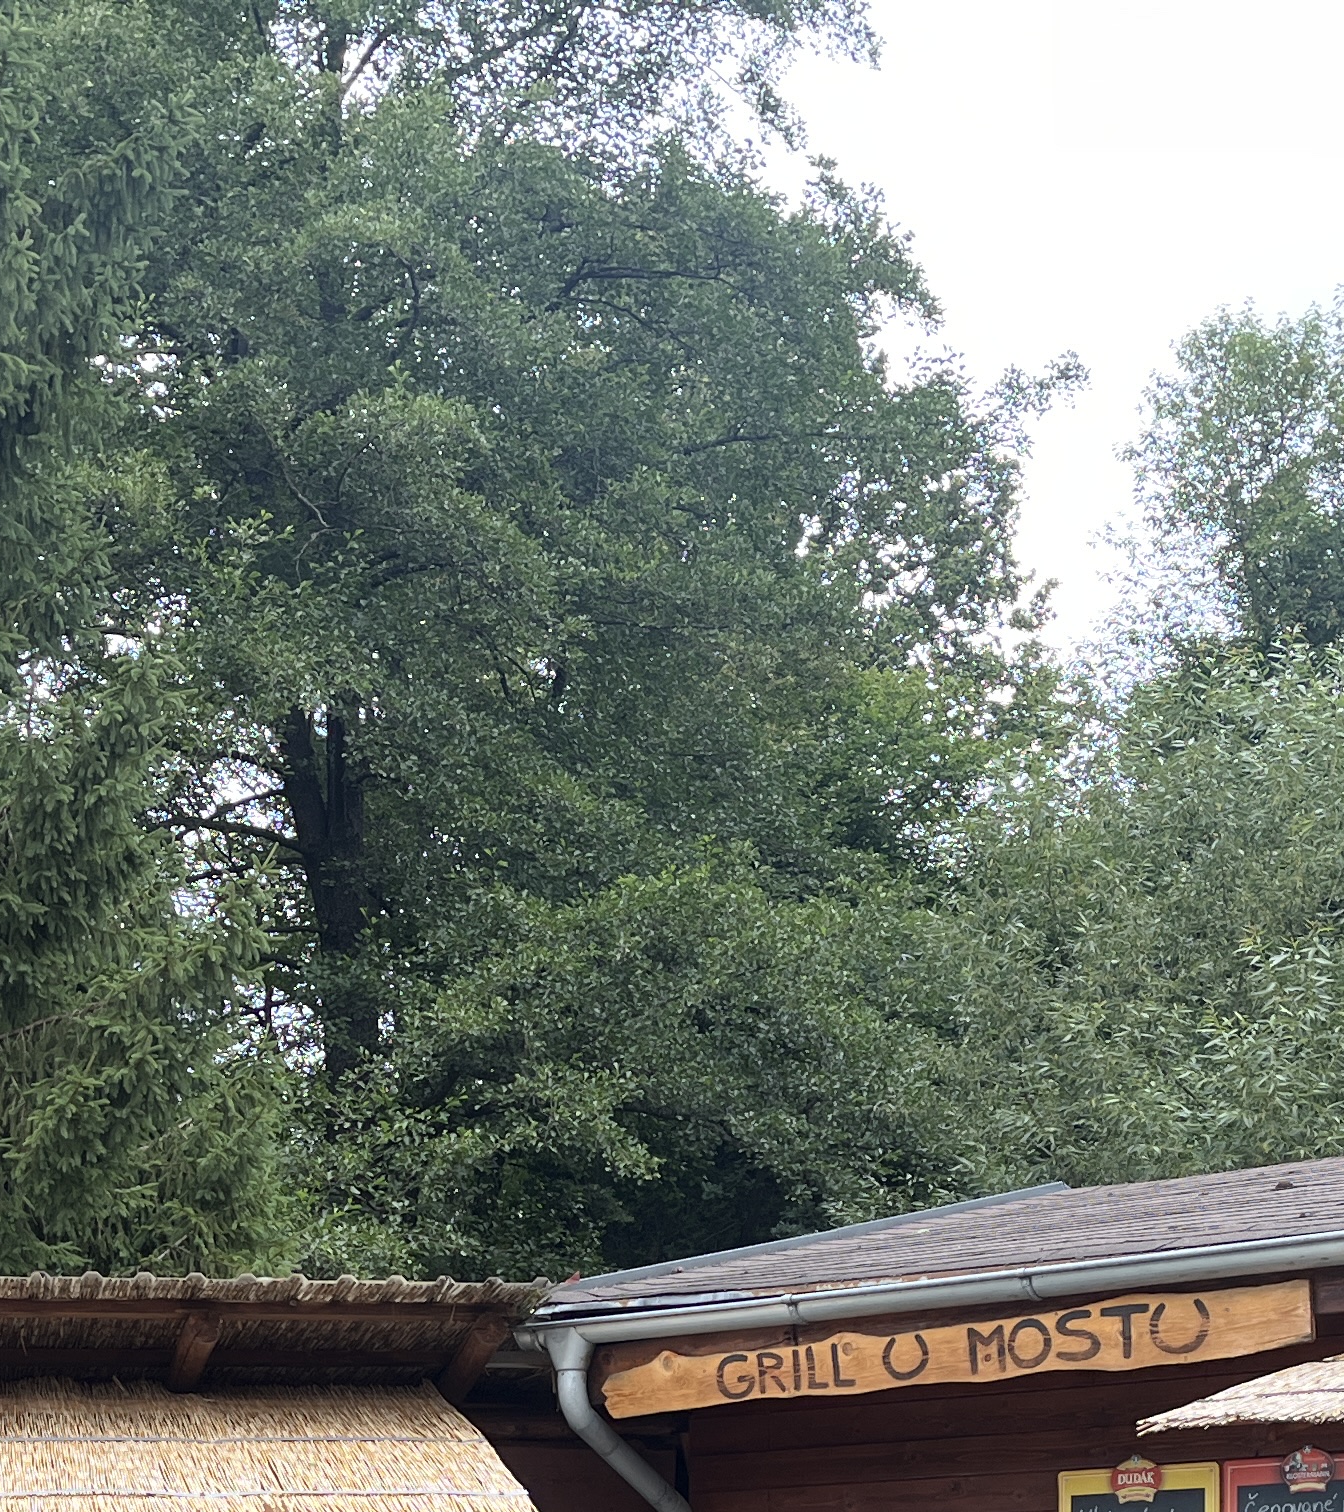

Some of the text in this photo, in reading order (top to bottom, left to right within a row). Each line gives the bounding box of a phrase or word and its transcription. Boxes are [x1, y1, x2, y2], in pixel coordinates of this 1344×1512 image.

[716, 1299, 1210, 1399] GRILL U MOSTU
